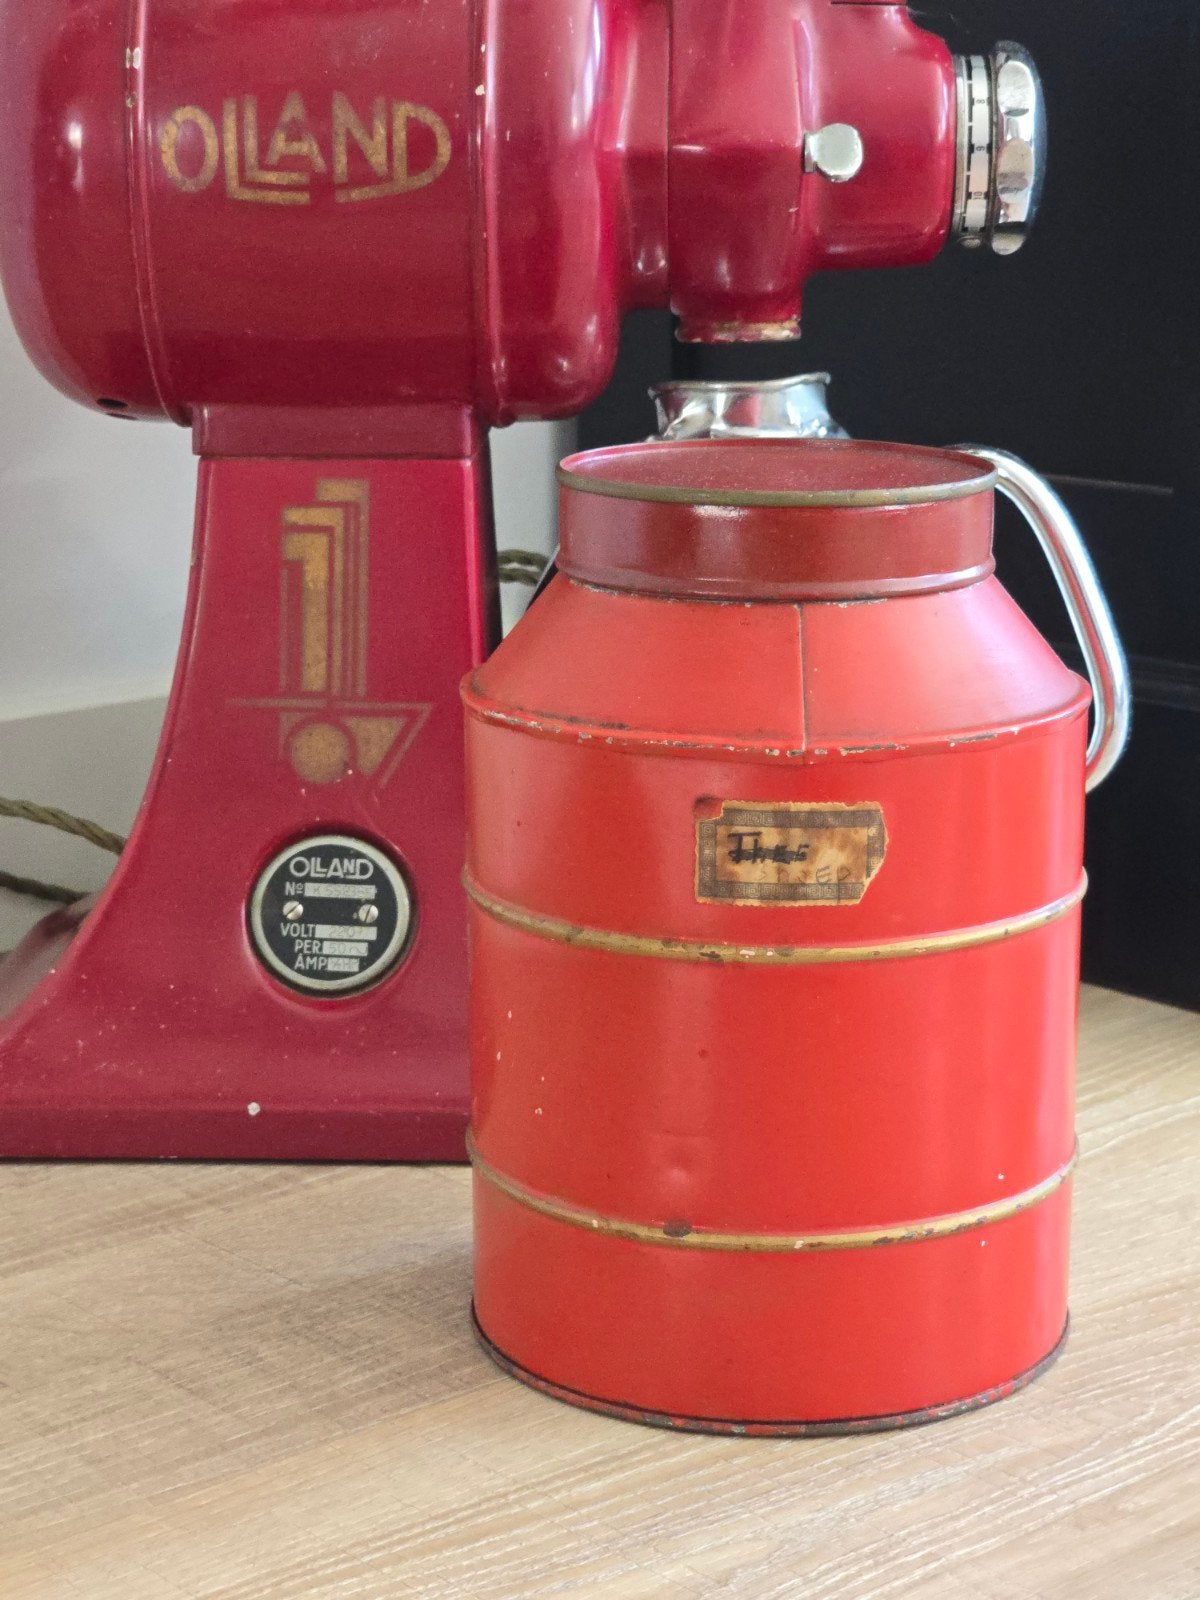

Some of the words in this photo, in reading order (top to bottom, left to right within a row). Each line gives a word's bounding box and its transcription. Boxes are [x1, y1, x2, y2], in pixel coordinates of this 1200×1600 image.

[159, 91, 451, 204] OLLAND
[290, 857, 373, 879] OLLAND
[280, 922, 316, 938] VOLT
